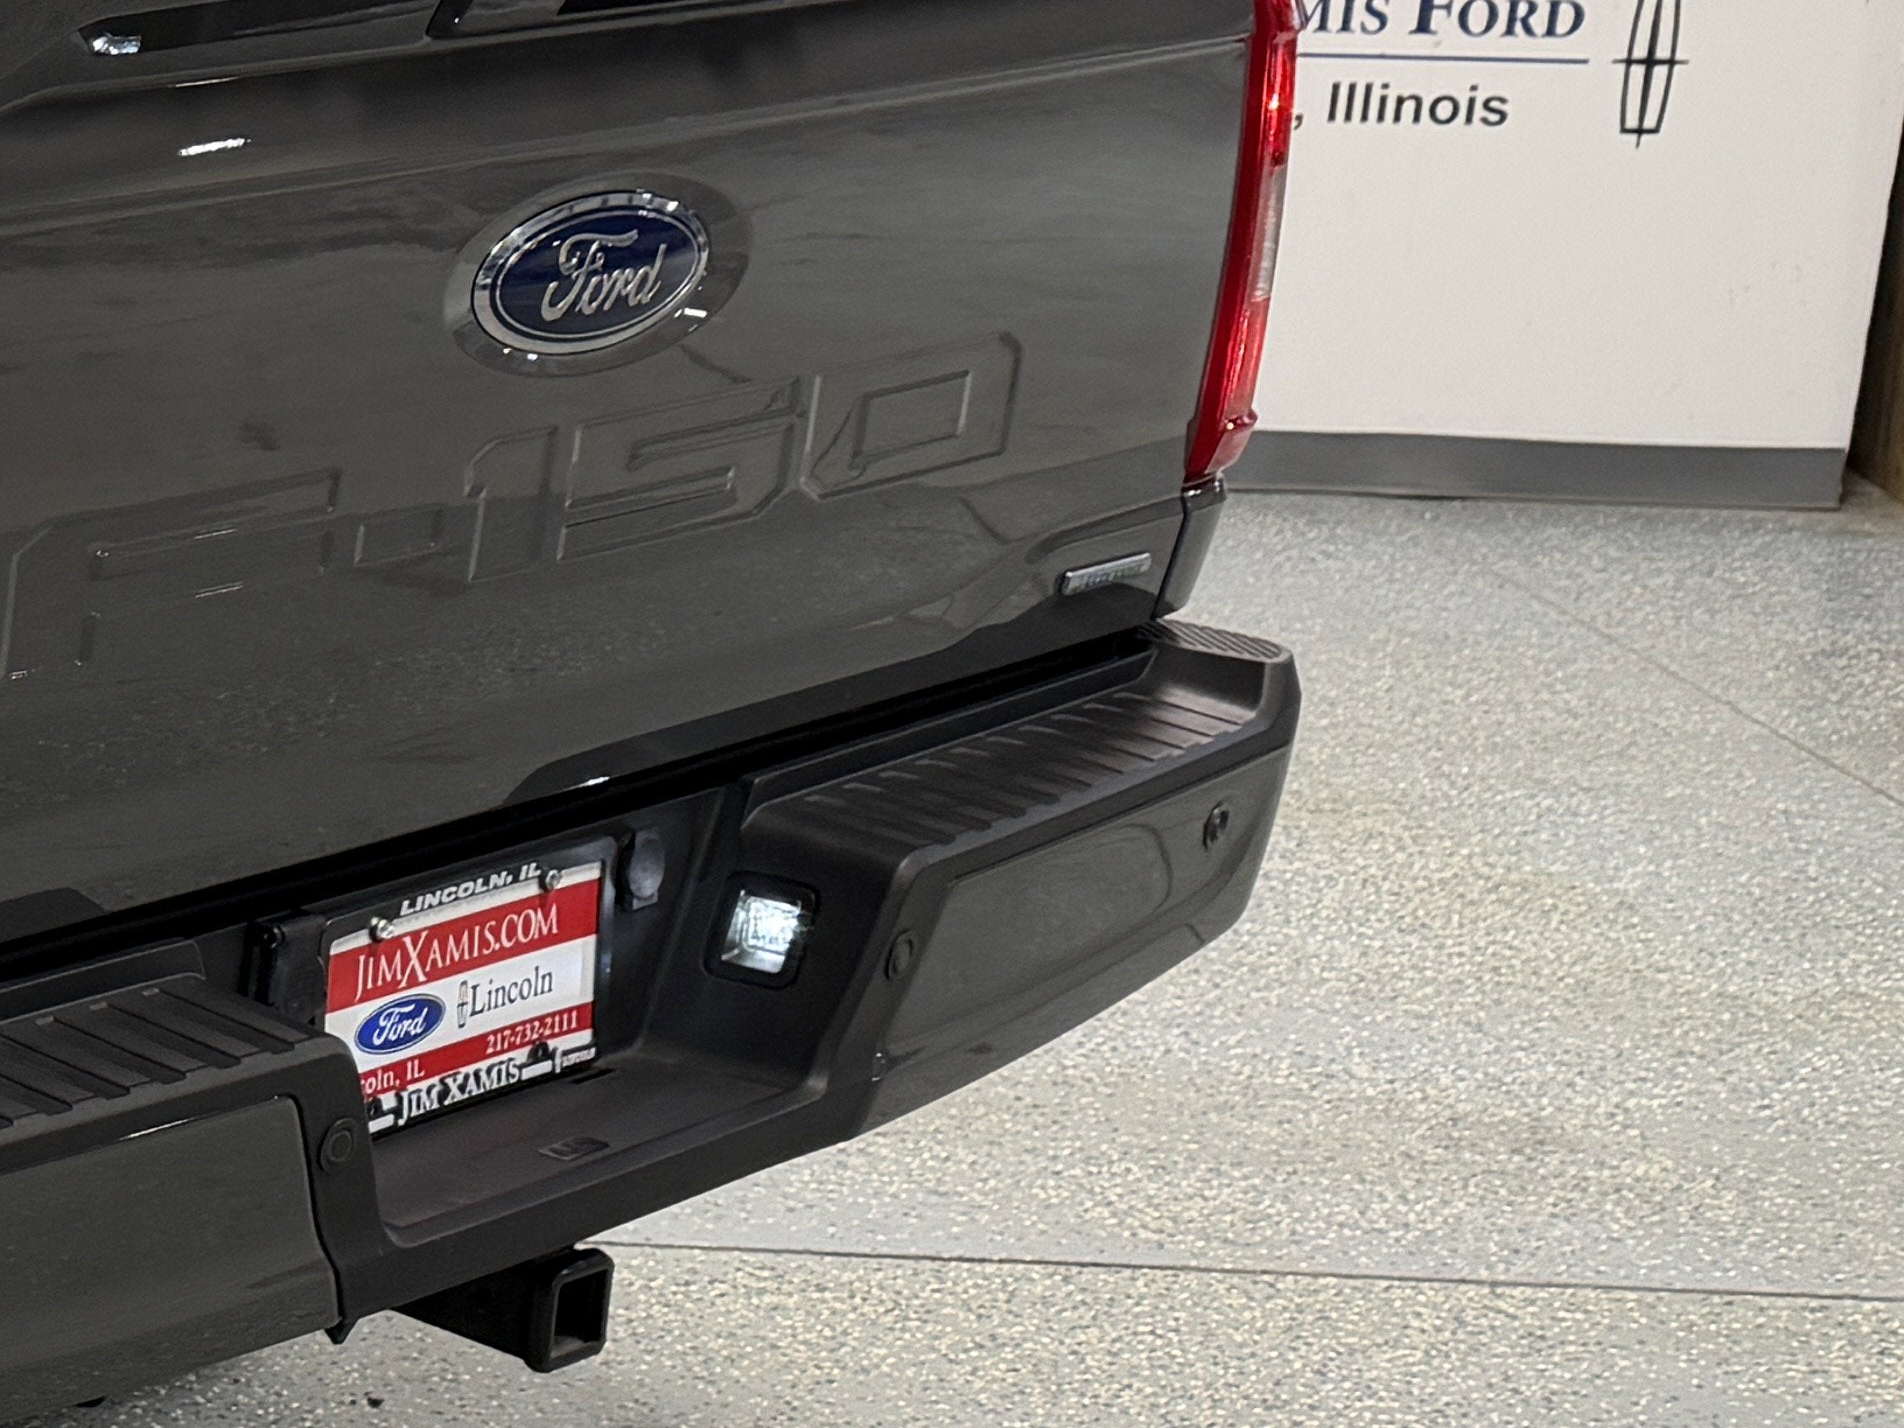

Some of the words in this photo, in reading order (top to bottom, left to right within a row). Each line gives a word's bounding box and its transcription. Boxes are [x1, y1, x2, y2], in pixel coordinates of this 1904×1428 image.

[1326, 82, 1510, 126] Illinois
[541, 229, 668, 322] Ford
[400, 870, 514, 916] LINCOLN,
[520, 863, 541, 880] IL
[354, 903, 559, 1002] JIMXAMIS.COM
[469, 966, 553, 1017] Lincoln
[372, 1002, 428, 1046] Ford
[485, 1008, 578, 1055] 217-732-2111
[397, 1083, 441, 1127] JIM
[443, 1055, 521, 1106] XAMIS
